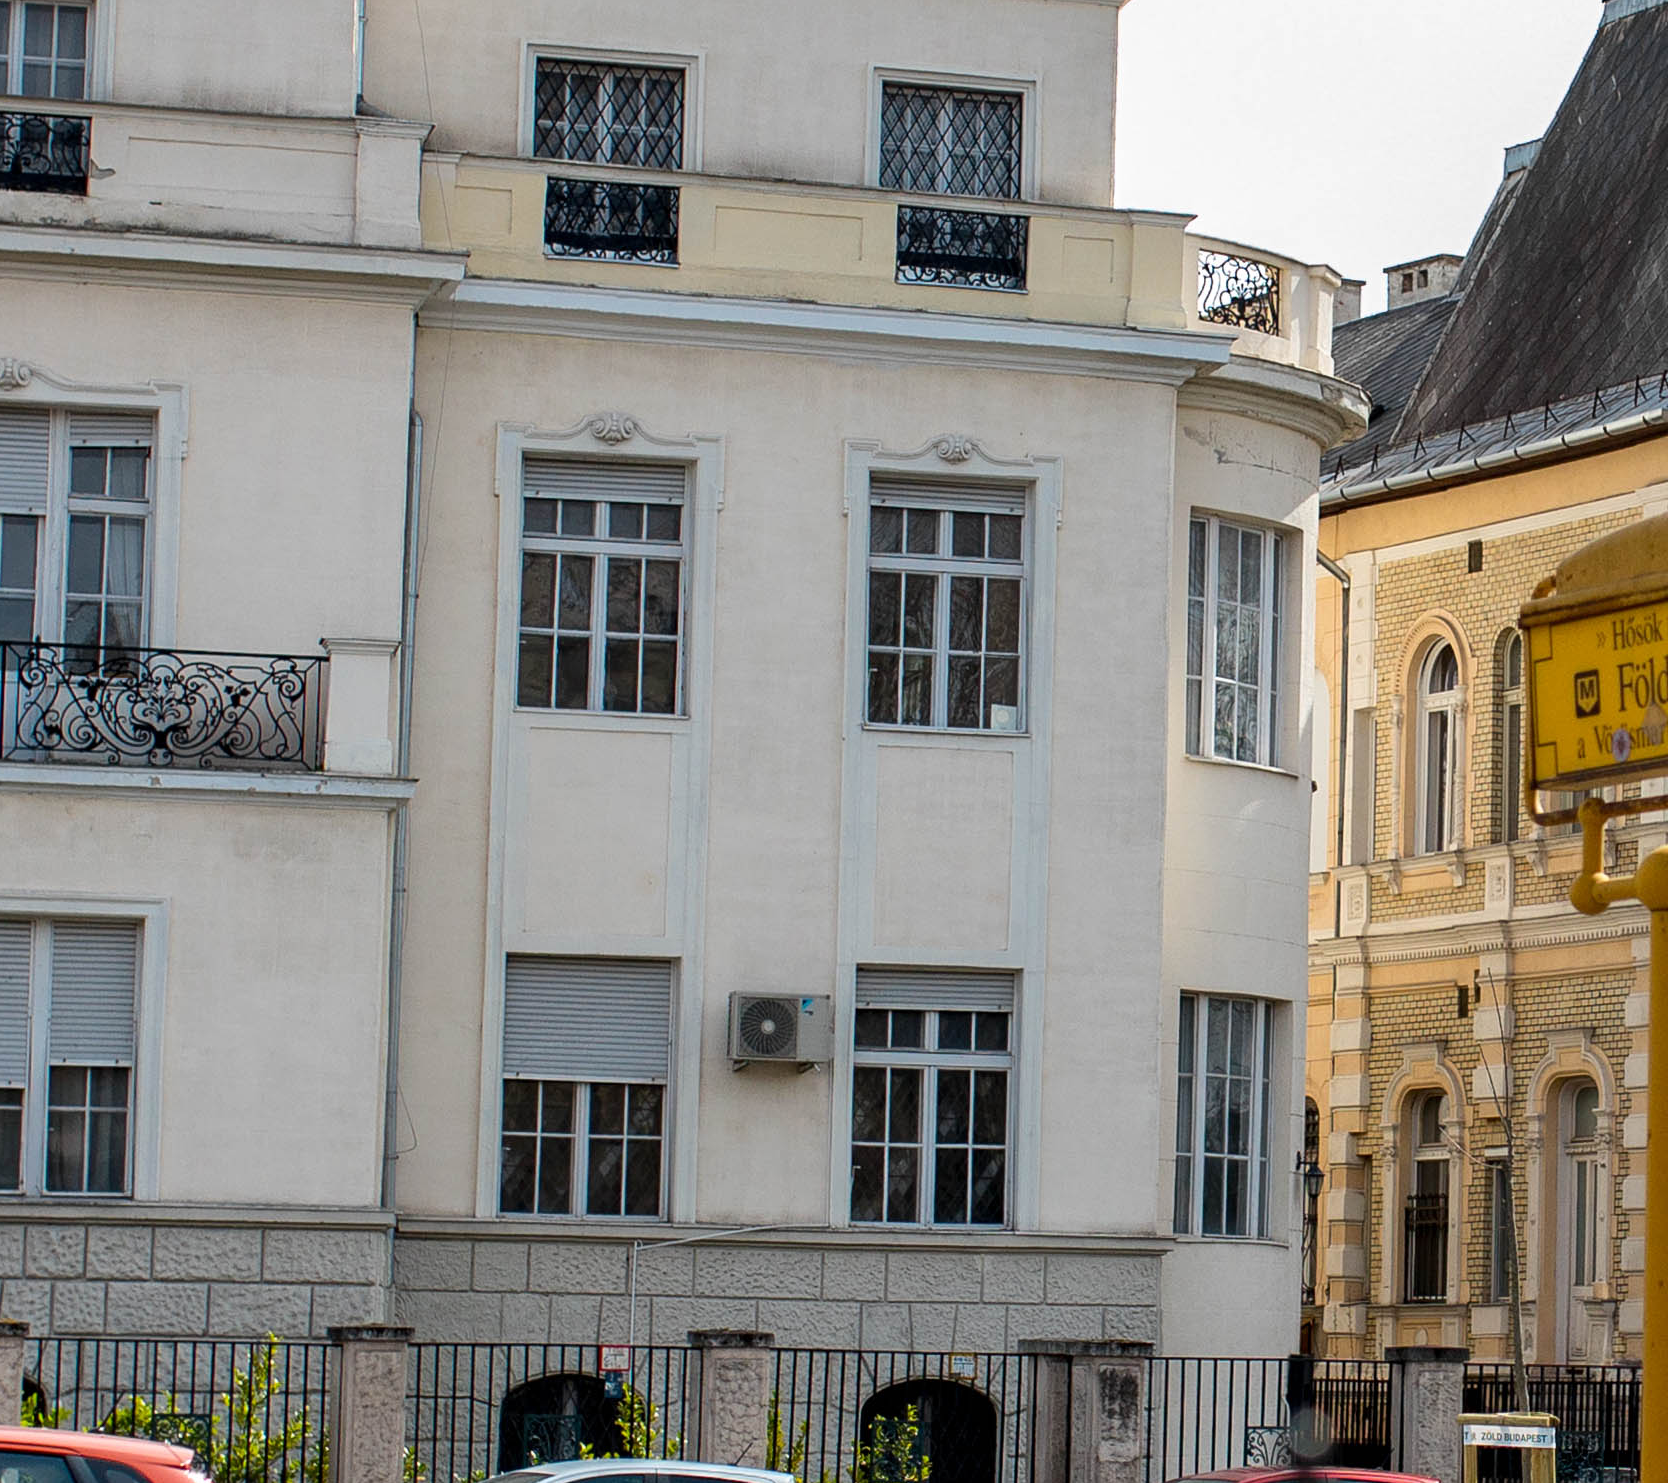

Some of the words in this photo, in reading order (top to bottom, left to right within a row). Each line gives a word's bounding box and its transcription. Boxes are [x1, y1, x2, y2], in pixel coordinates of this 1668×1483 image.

[1612, 614, 1663, 651] Hősök
[1577, 737, 1586, 759] a
[1504, 1432, 1549, 1443] BUDAPEST
